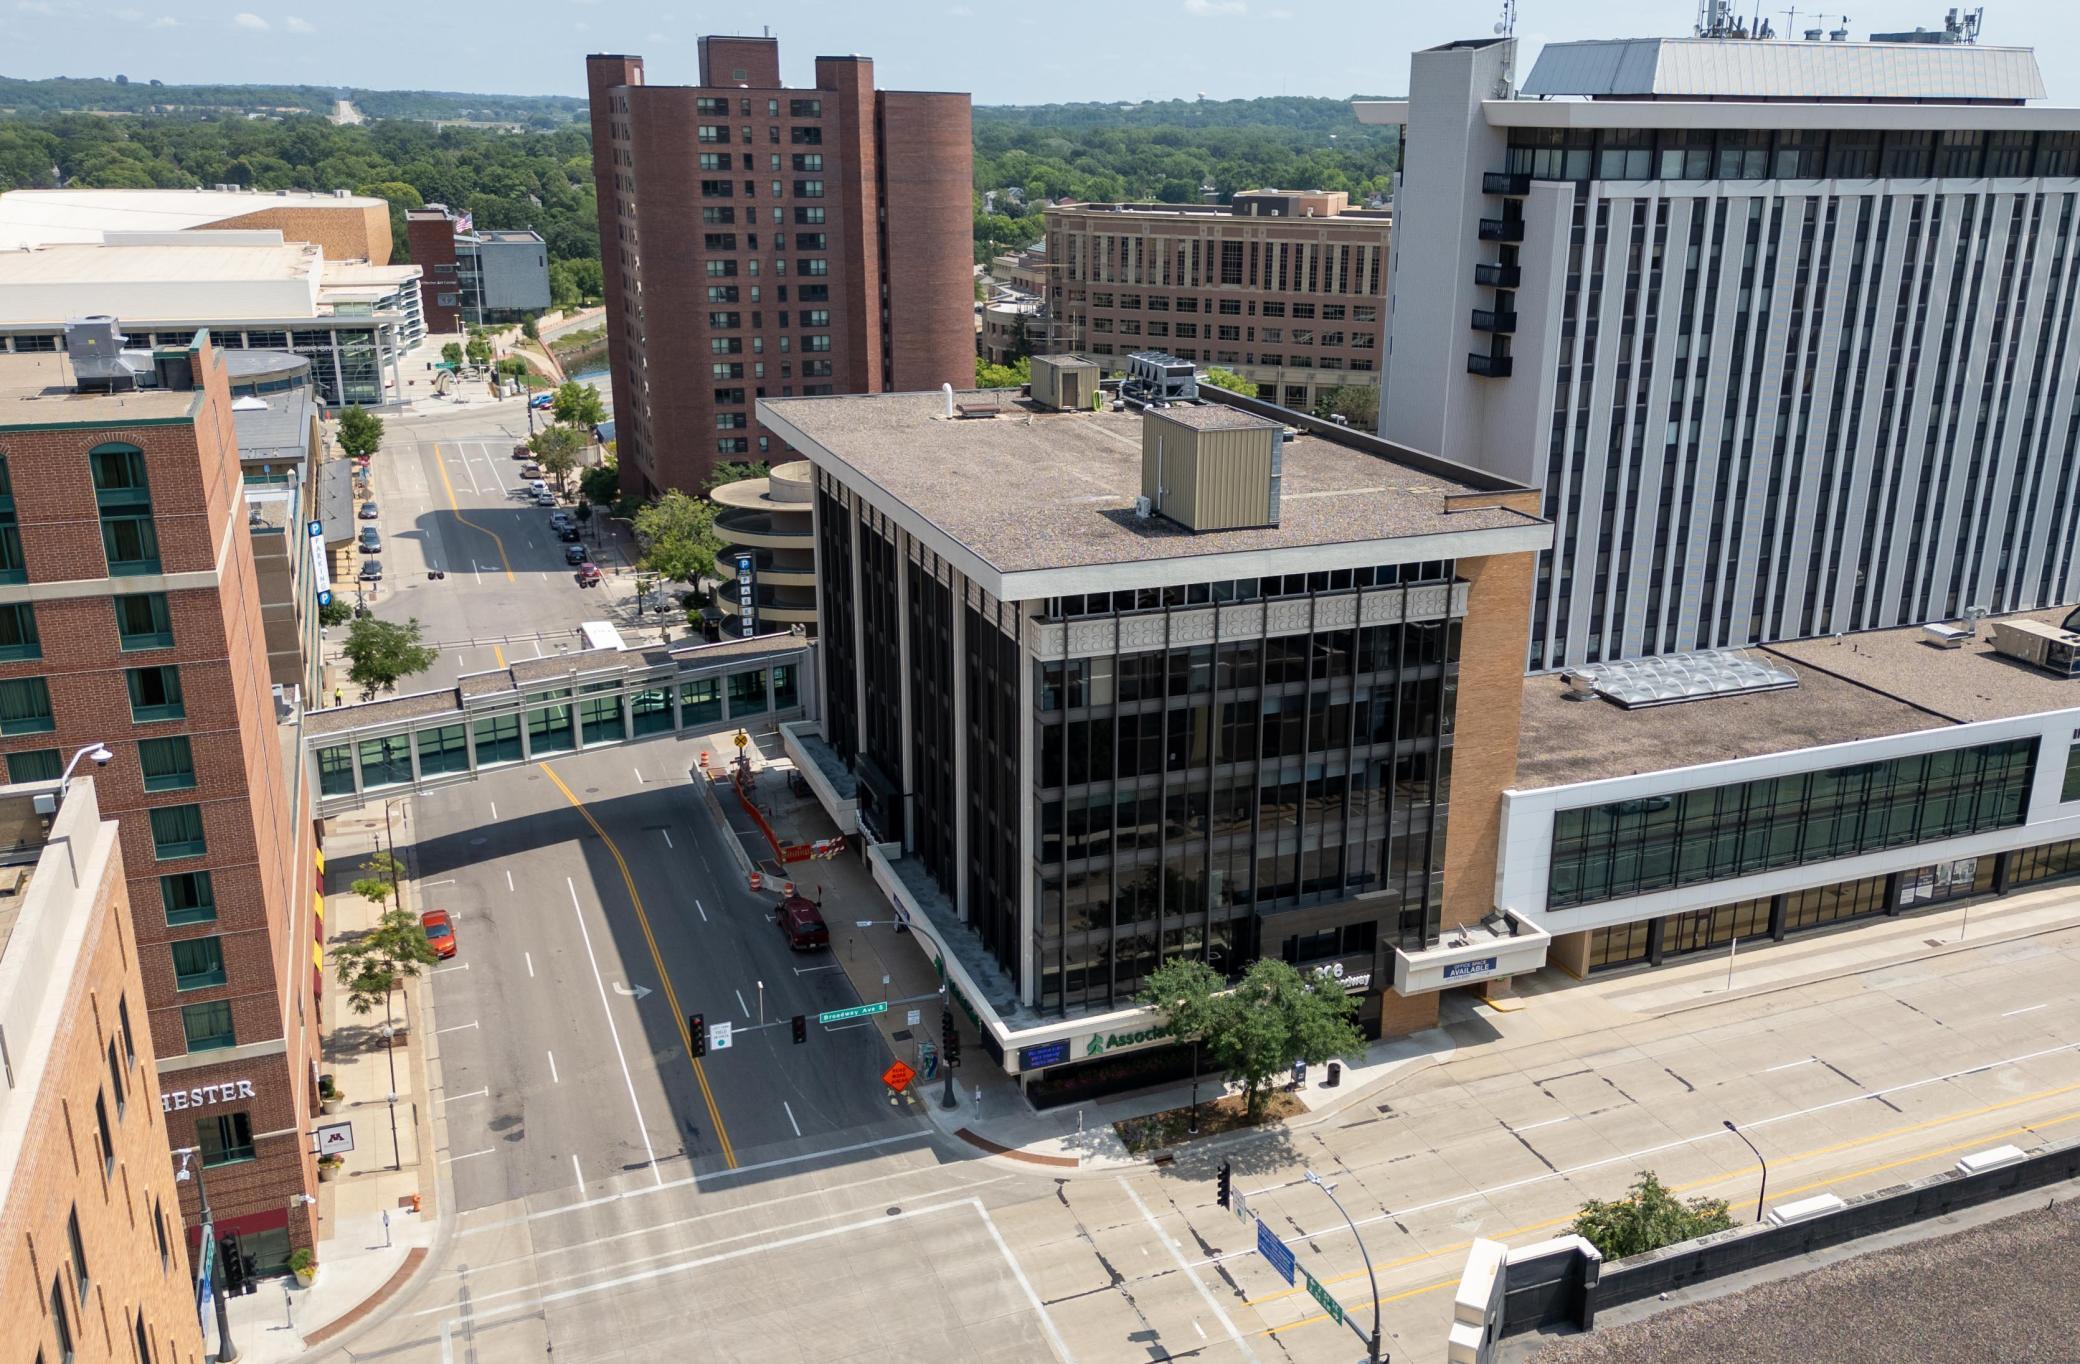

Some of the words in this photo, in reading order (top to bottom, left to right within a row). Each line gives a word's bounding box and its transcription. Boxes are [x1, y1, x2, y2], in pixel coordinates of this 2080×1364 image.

[312, 523, 320, 535] P
[321, 593, 330, 605] P
[1449, 963, 1490, 977] AVAILABLE
[823, 1010, 859, 1021] Broadway
[862, 1006, 876, 1014] Ave
